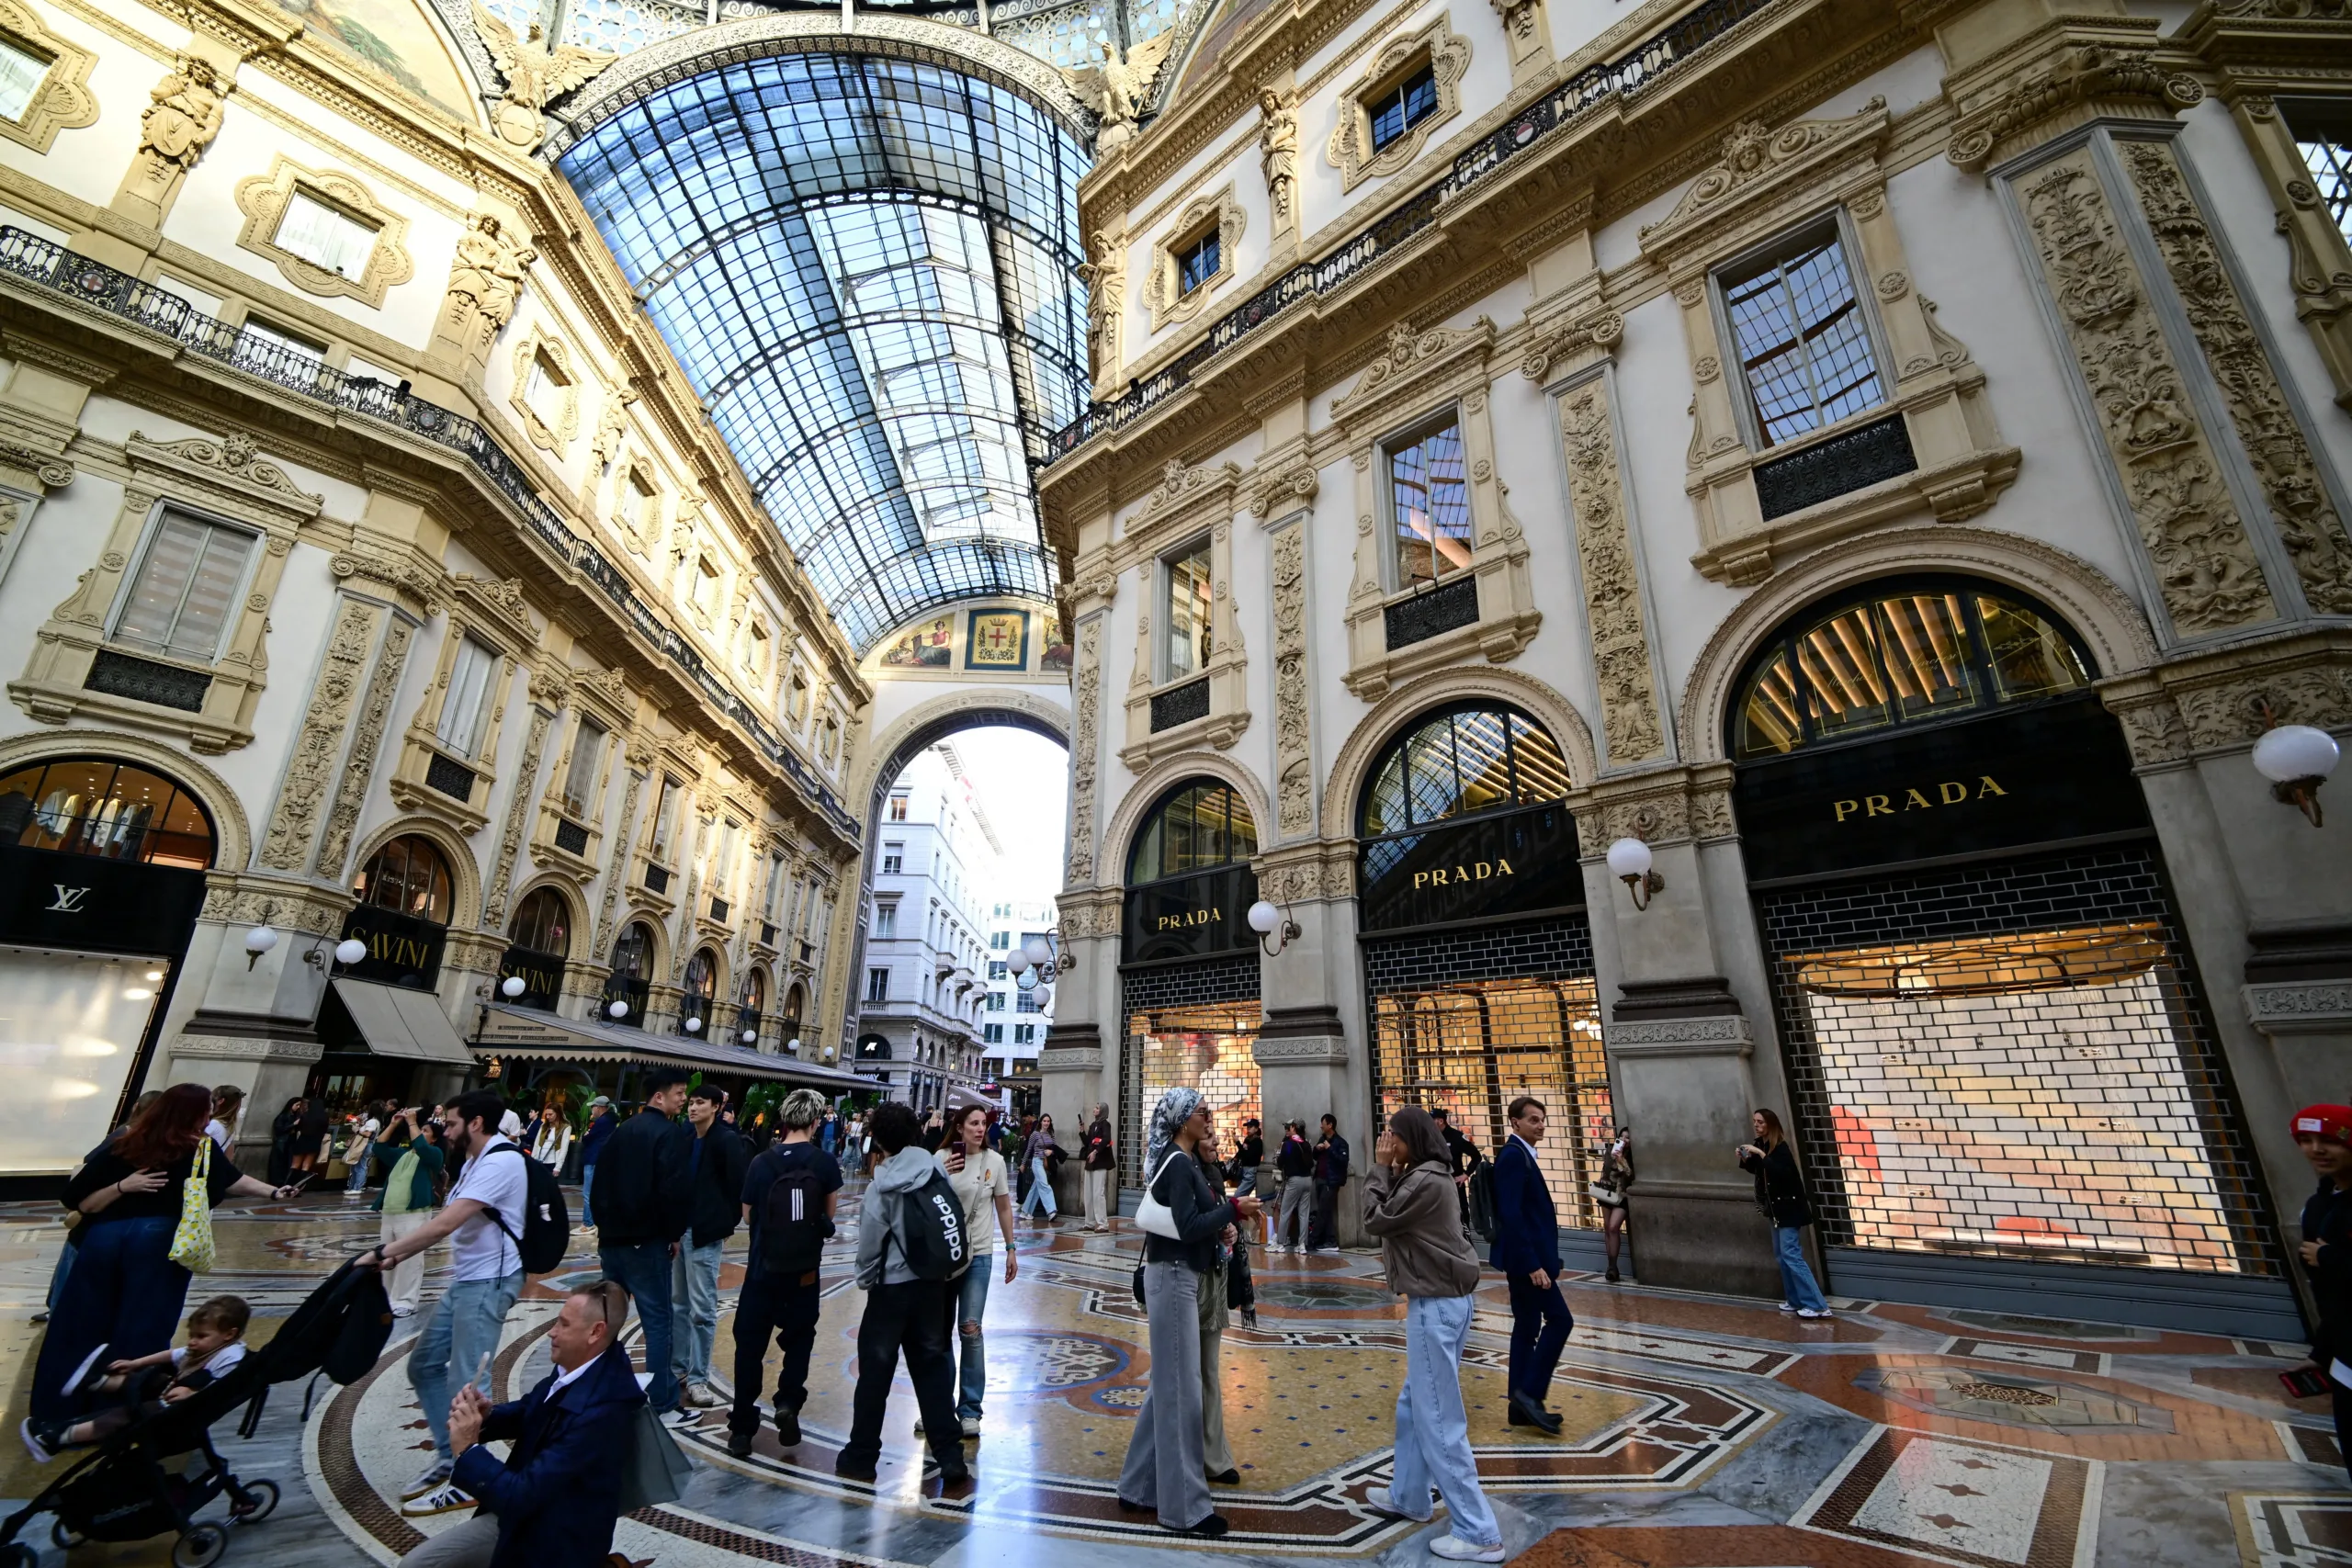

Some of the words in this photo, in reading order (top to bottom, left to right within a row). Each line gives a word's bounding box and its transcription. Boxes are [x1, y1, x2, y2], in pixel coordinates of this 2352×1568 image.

[1833, 775, 2009, 822] PRADA
[1414, 859, 1514, 889] PRADA
[1159, 908, 1222, 930] PRADA
[933, 1194, 963, 1261] adidas
